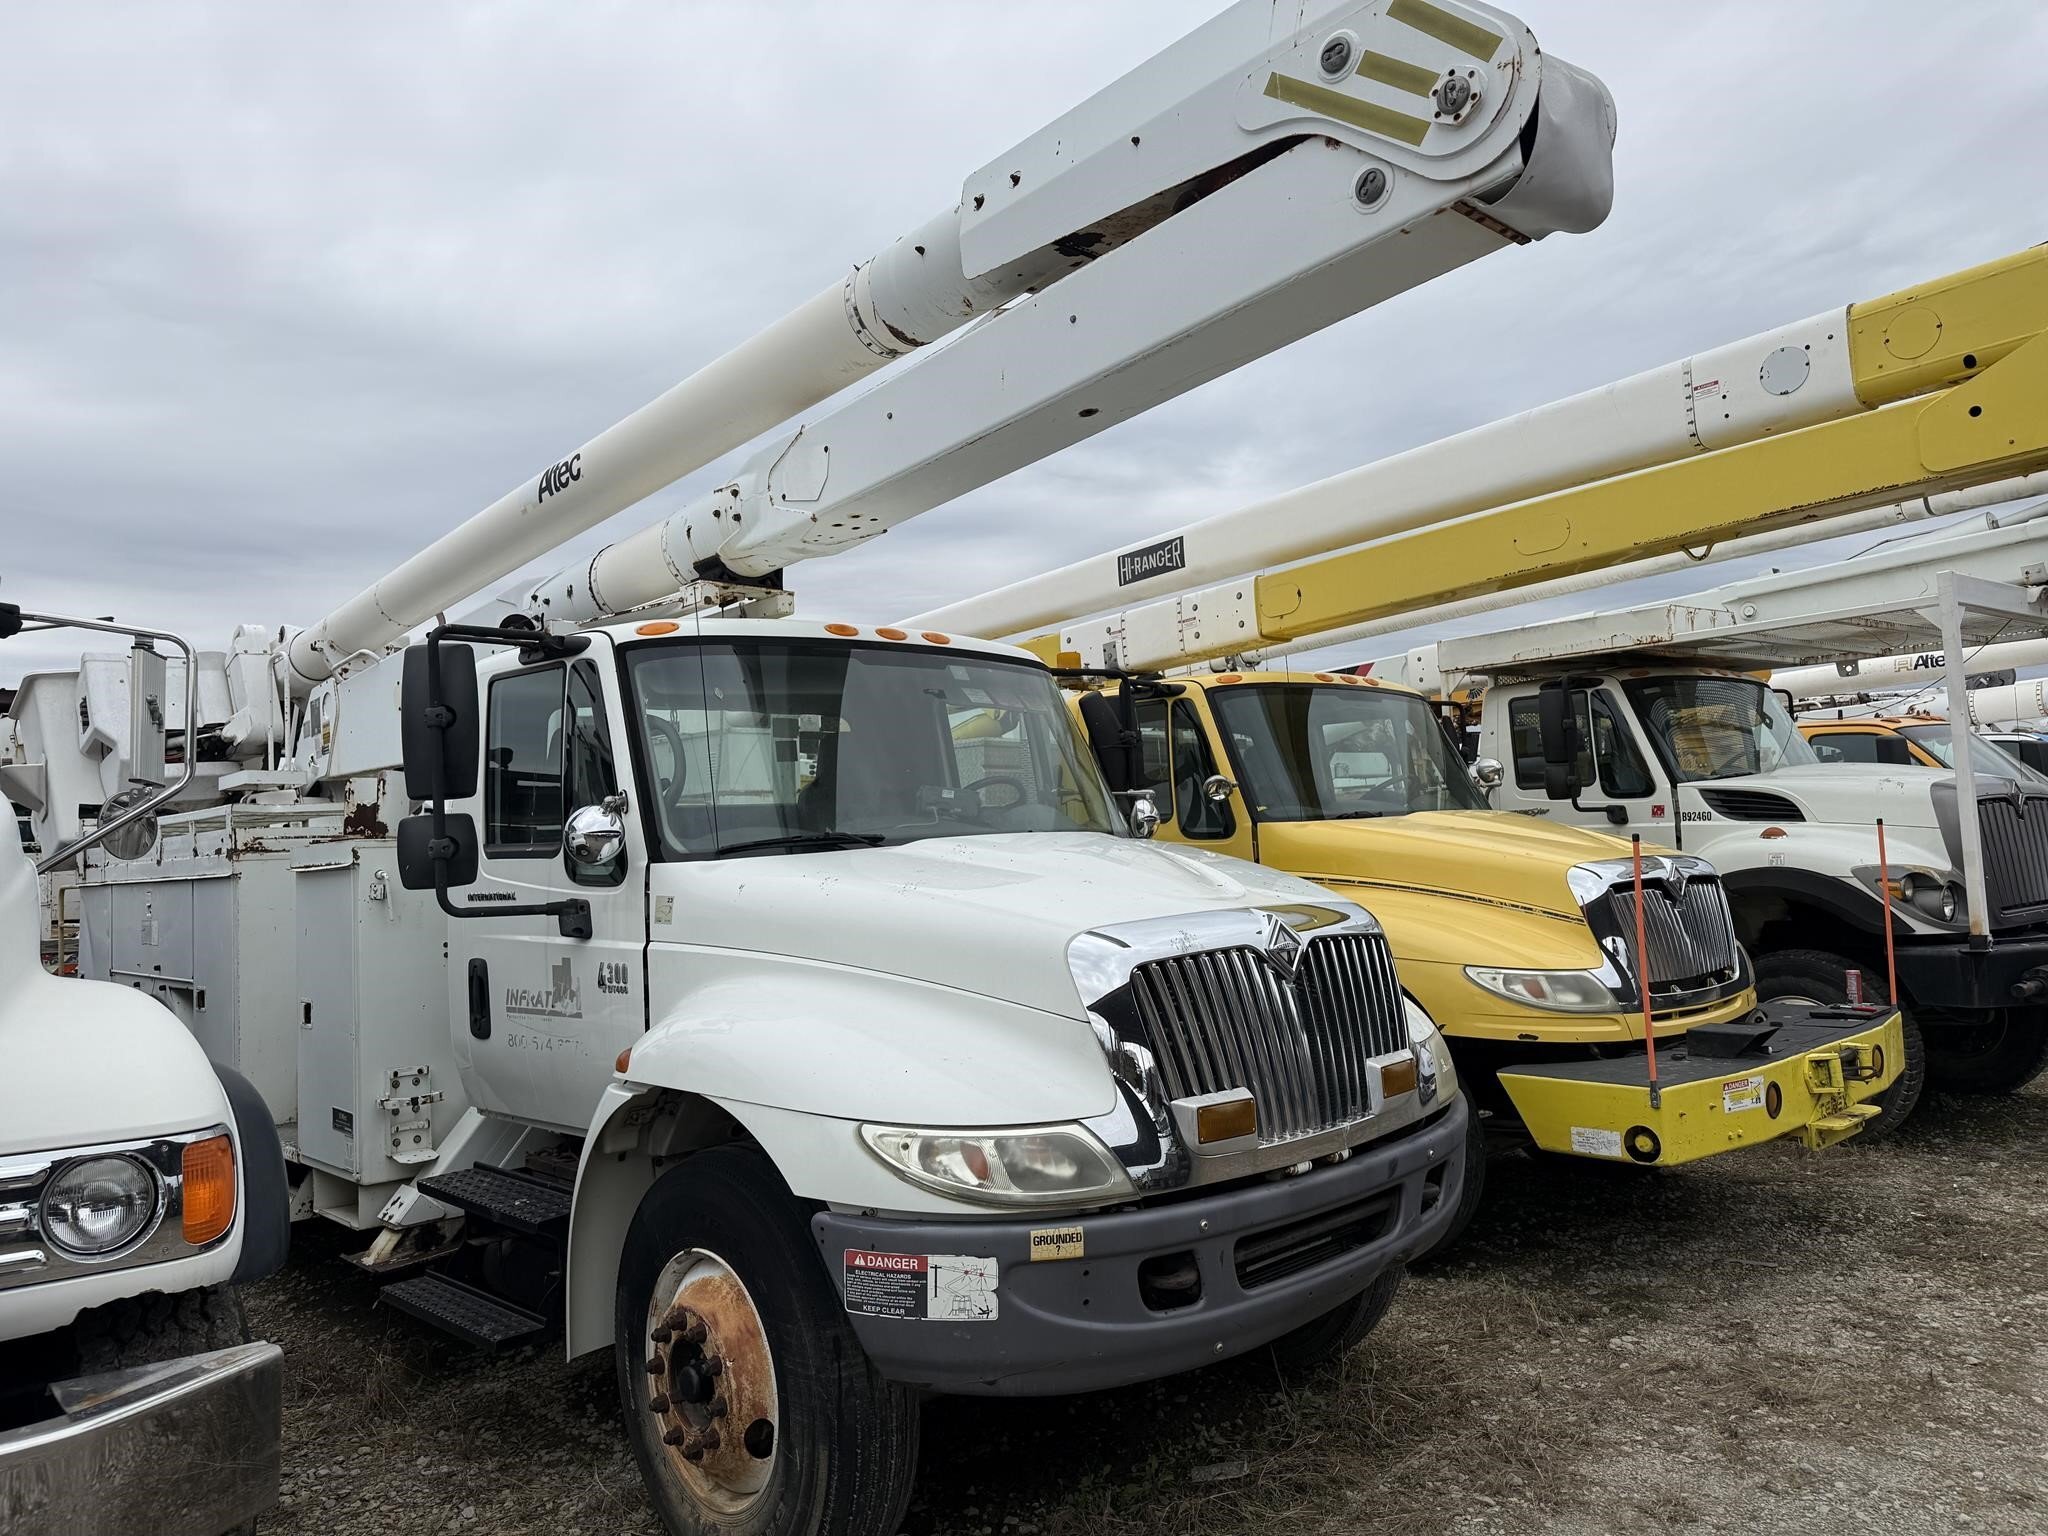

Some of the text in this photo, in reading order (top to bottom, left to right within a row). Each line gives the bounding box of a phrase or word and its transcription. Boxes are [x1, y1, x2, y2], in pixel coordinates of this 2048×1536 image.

[538, 453, 581, 504] Altec
[1119, 538, 1182, 585] HI-RANGER
[1913, 654, 1945, 670] Alte
[1682, 811, 1712, 821] B92460
[467, 891, 517, 902] INTERNATIONAL
[1033, 1232, 1083, 1246] GROUNDED
[1056, 1244, 1061, 1256] ?
[867, 1255, 919, 1270] DANGER
[855, 1269, 885, 1278] ELECTRICAL
[863, 1304, 905, 1315] KEEP CLEAR
